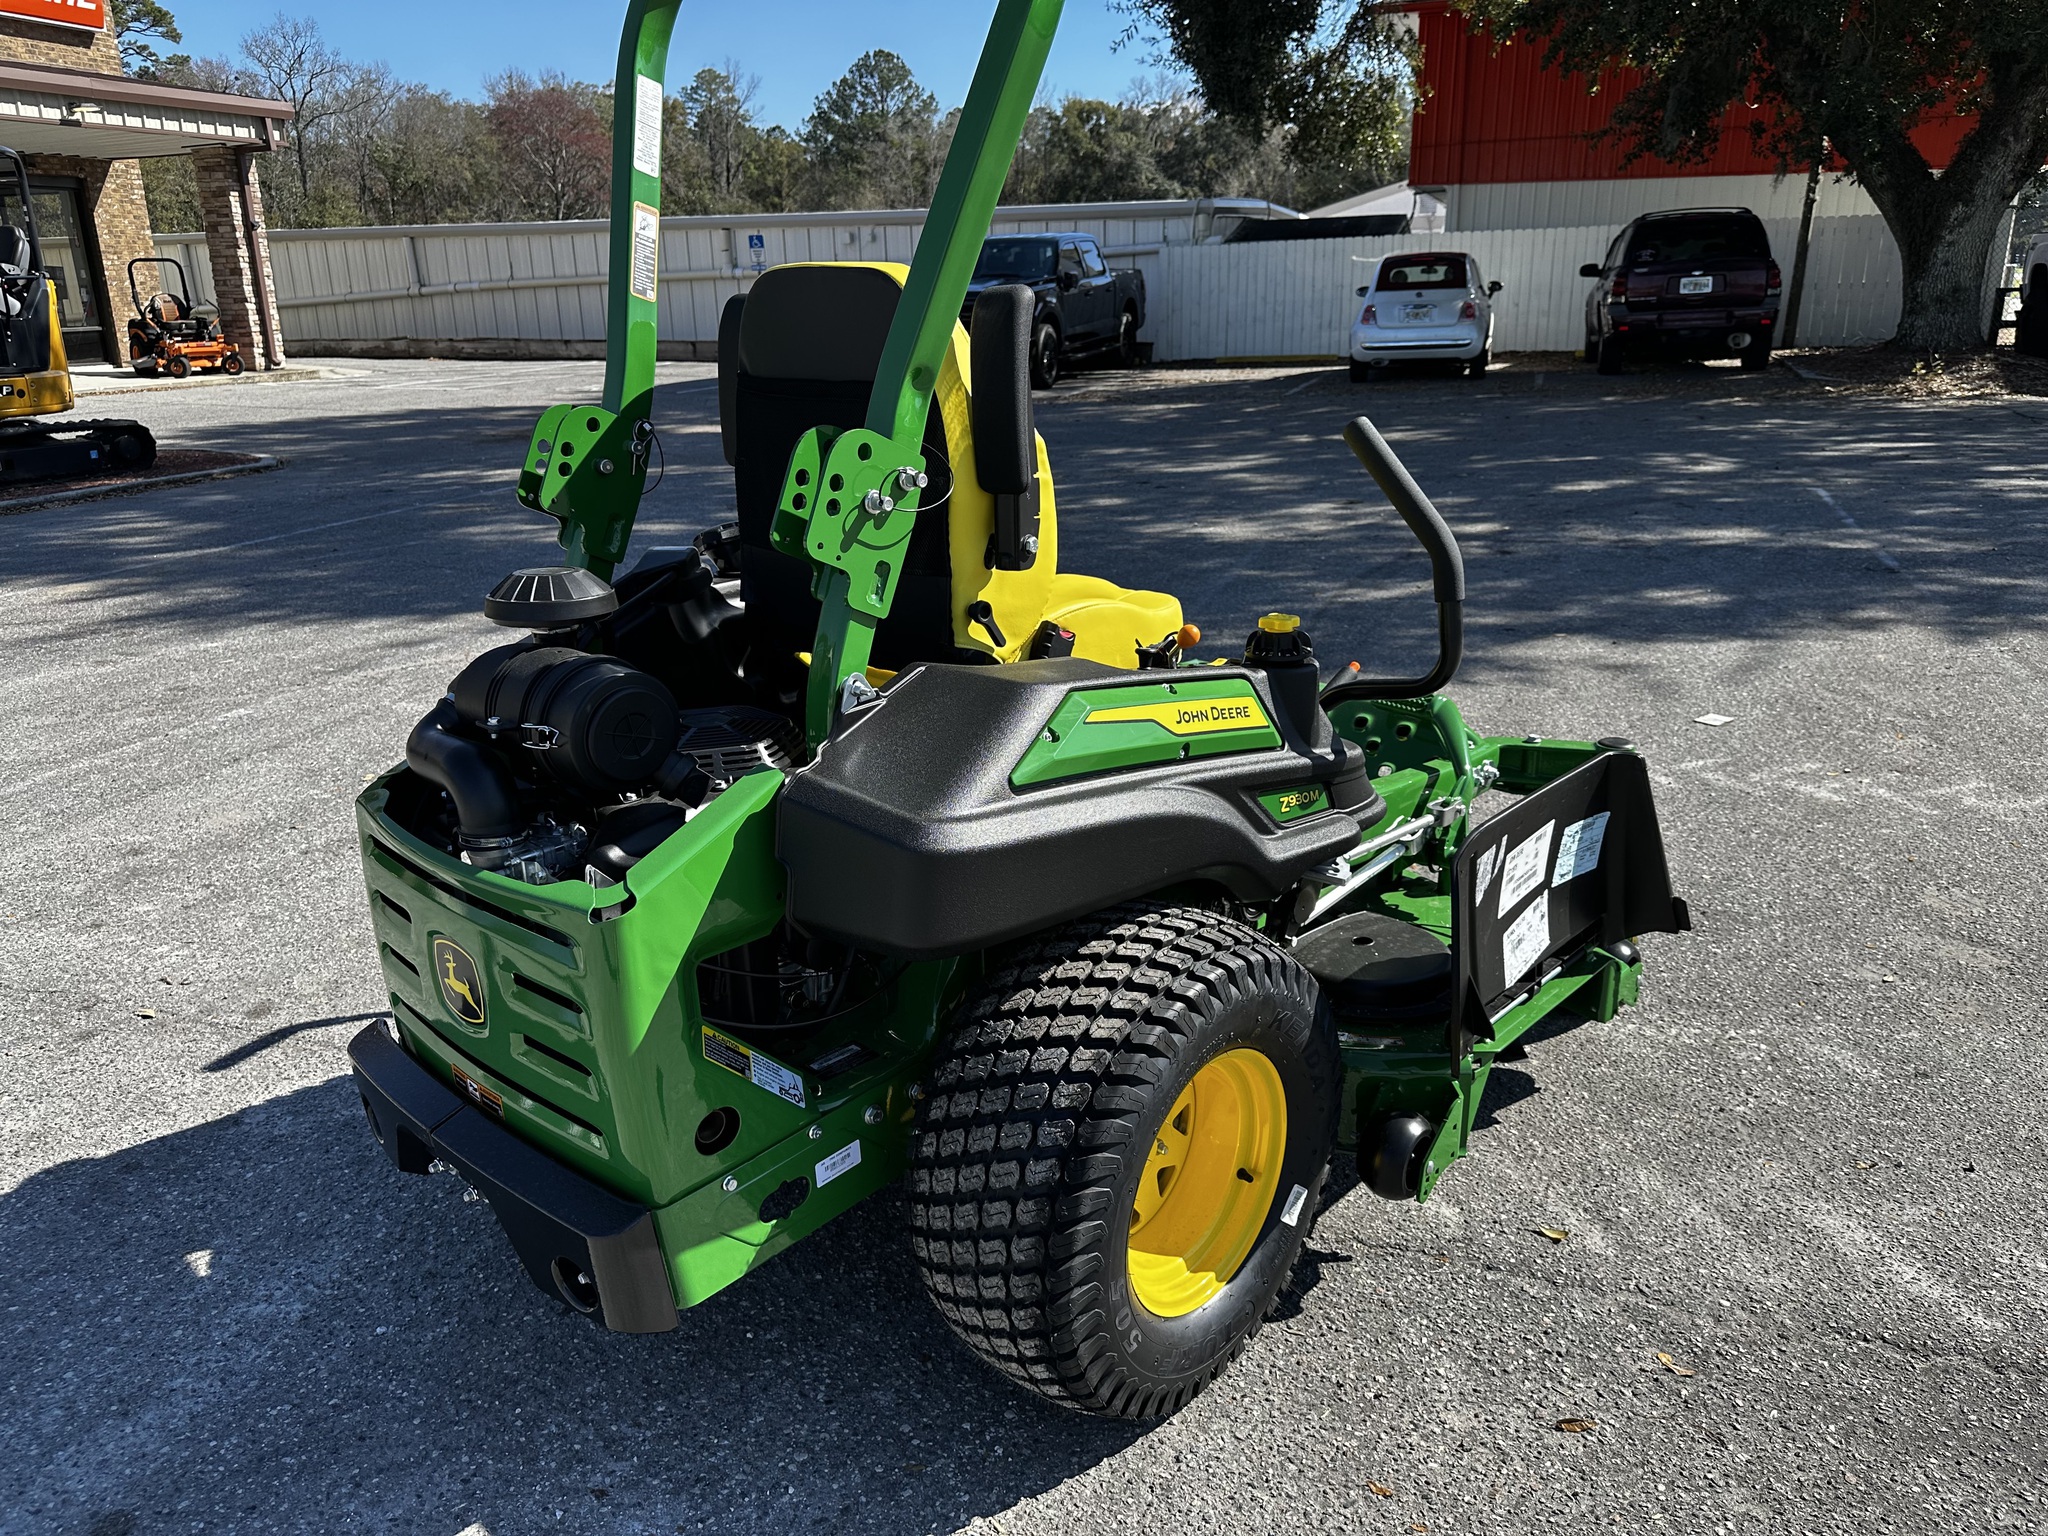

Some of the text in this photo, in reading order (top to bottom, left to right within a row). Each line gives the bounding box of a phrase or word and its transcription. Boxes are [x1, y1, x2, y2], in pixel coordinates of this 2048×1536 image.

[1176, 706, 1250, 724] JOHN DEERE
[1280, 789, 1319, 812] Z930M
[717, 1034, 740, 1051] CAUTION
